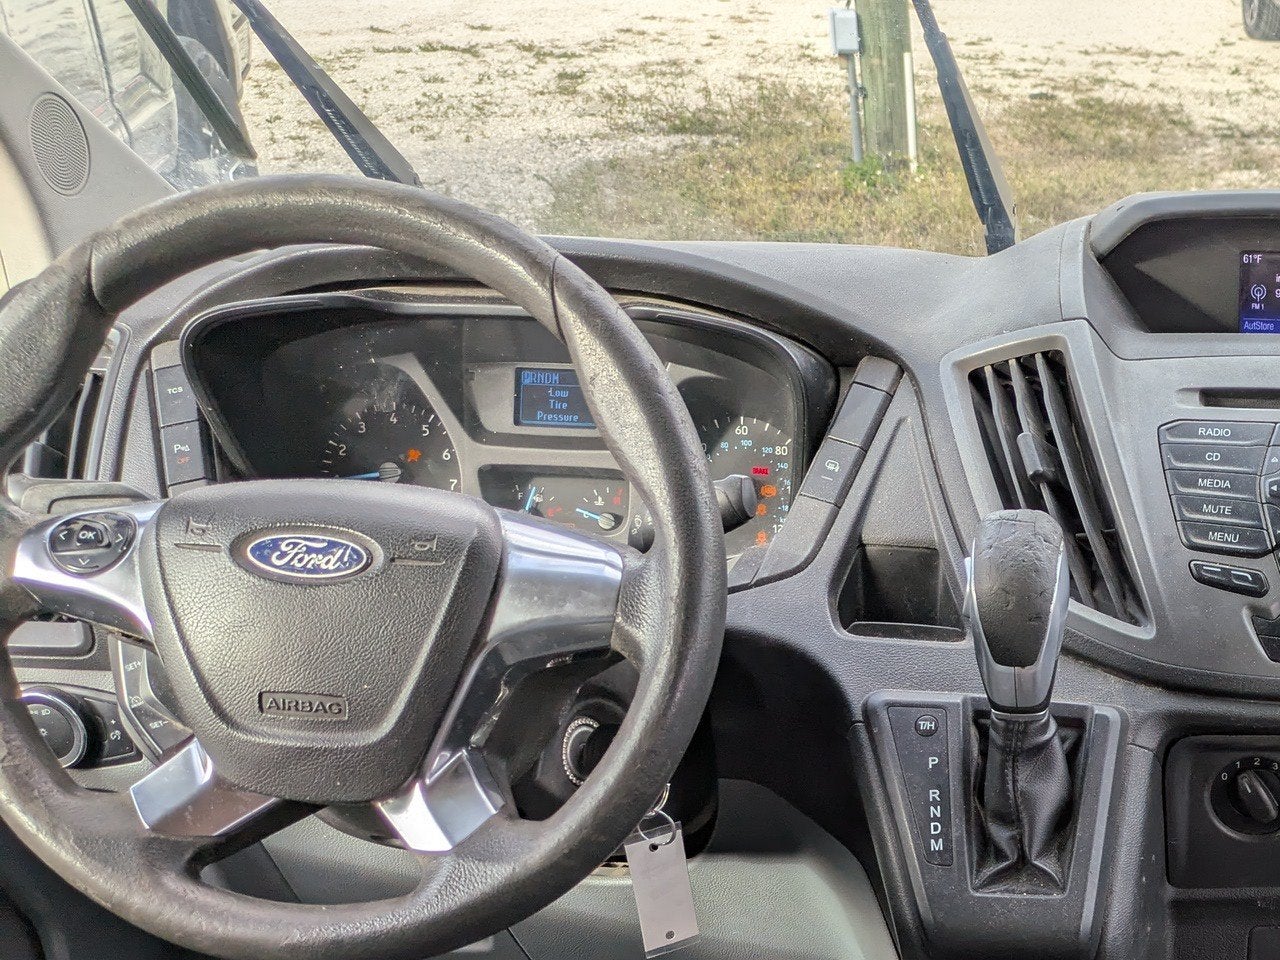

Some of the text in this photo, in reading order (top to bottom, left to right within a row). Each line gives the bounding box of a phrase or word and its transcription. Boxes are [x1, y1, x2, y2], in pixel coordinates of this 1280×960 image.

[1243, 254, 1262, 264] 61°F
[1243, 321, 1275, 331] AutStore
[550, 388, 569, 397] Low
[549, 400, 568, 409] Tire
[389, 413, 397, 424] 4
[537, 411, 579, 422] Pressure
[358, 422, 366, 433] 3
[422, 425, 429, 436] 5
[735, 426, 748, 435] 60
[1198, 427, 1231, 437] RADIO
[338, 444, 346, 456] 2
[442, 449, 450, 460] 6
[775, 446, 788, 456] 80
[1205, 452, 1221, 461] CD
[450, 480, 457, 491] 7
[1198, 478, 1231, 489] MEDIA
[1202, 504, 1232, 515] MUTE
[79, 531, 96, 540] OK
[1208, 531, 1239, 543] MENU
[271, 539, 344, 570] Ford
[266, 698, 342, 715] AIRBAG
[919, 721, 935, 730] T/H
[928, 757, 939, 768] P
[1235, 761, 1241, 769] 1
[1254, 758, 1261, 766] 2
[1272, 762, 1279, 770] 3
[1221, 773, 1228, 781] 0
[929, 790, 940, 801] R
[930, 806, 940, 817] N
[930, 822, 941, 834] D
[930, 839, 943, 851] M
